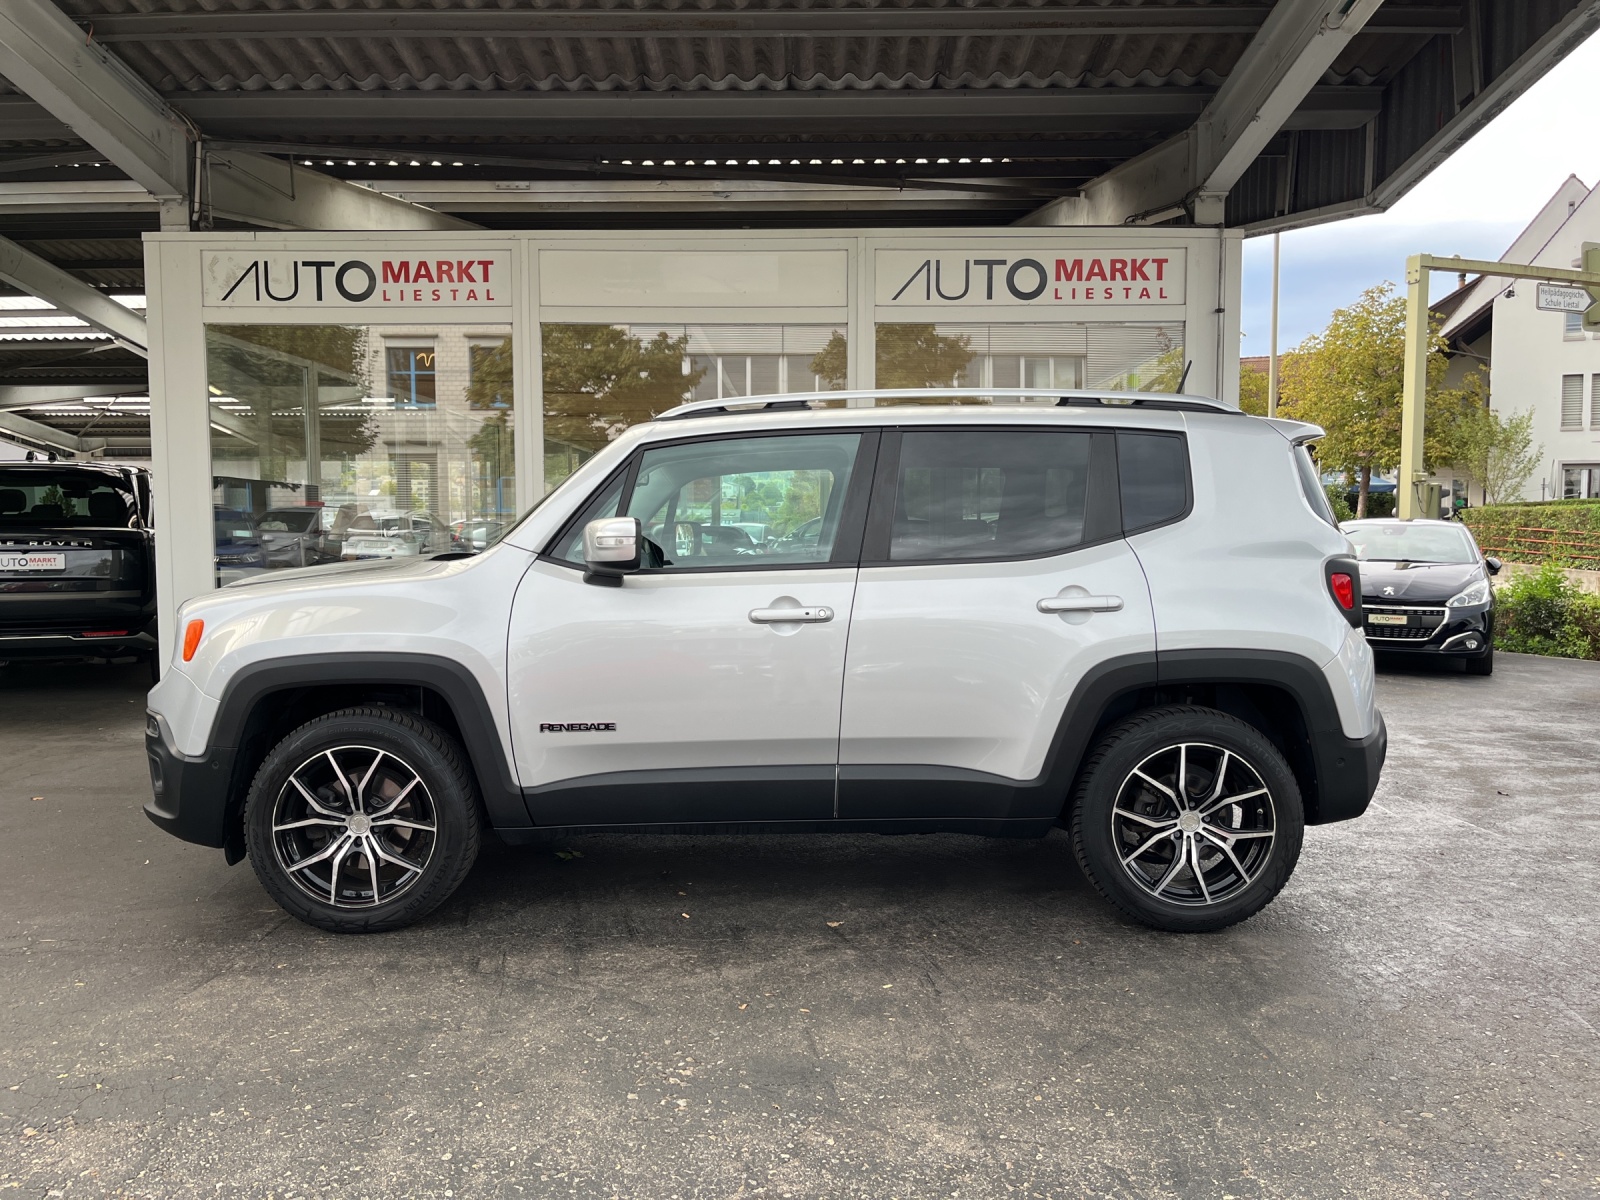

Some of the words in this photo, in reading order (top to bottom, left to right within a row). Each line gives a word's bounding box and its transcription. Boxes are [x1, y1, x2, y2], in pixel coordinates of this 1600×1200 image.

[221, 260, 377, 302] AUTO
[381, 260, 494, 283] MARKT
[891, 258, 1048, 301] AUTO
[1054, 258, 1169, 282] MARKT
[382, 289, 495, 302] LIESTAL
[1054, 287, 1168, 300] LIESTAL
[1540, 287, 1585, 300] Heilpädagogische
[1545, 298, 1562, 308] Schule
[1563, 300, 1580, 309] Liestal
[0, 557, 29, 567] UTO
[539, 722, 617, 733] RENEGADE
[403, 852, 453, 914] VREDESTEIN
